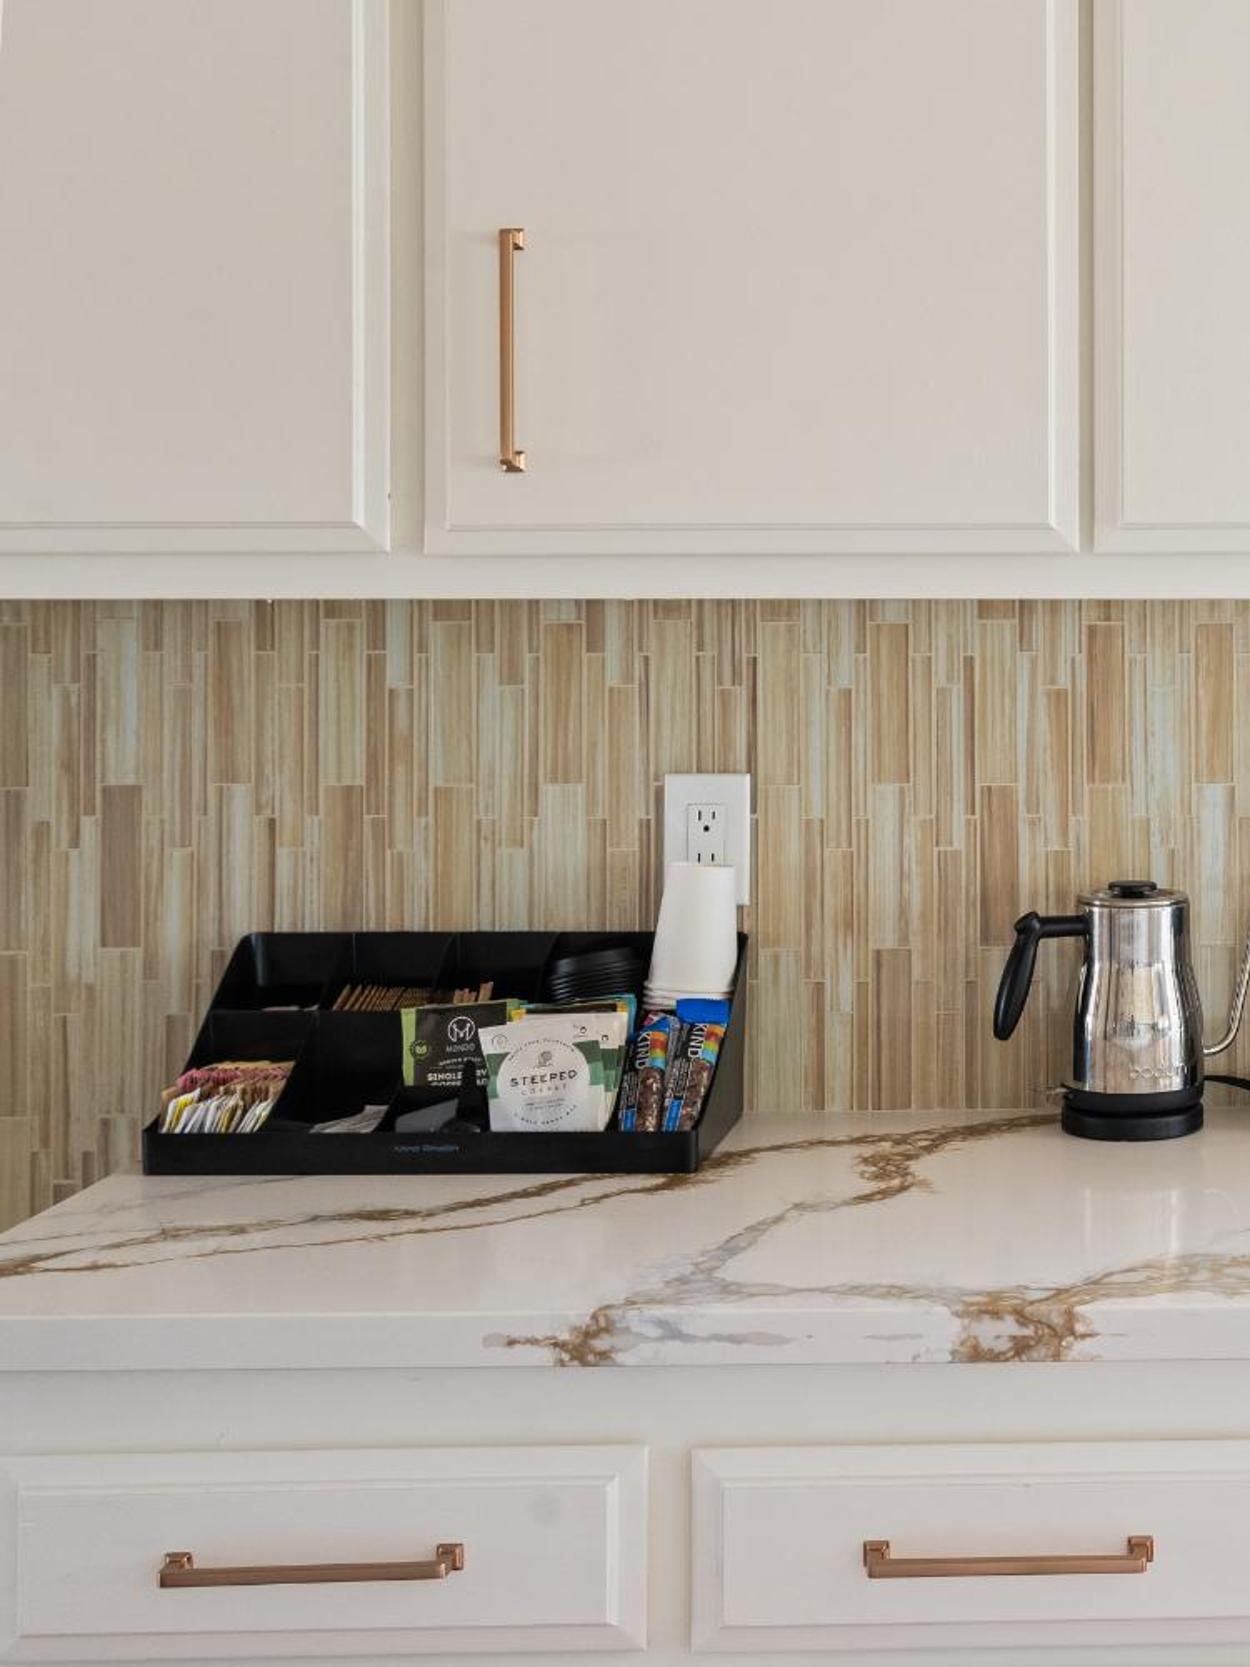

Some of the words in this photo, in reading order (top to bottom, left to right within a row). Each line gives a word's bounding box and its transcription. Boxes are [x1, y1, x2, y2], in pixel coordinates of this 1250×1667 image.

[633, 1029, 652, 1070] KIND
[688, 1023, 709, 1058] KIND
[510, 1068, 578, 1088] STEEPED
